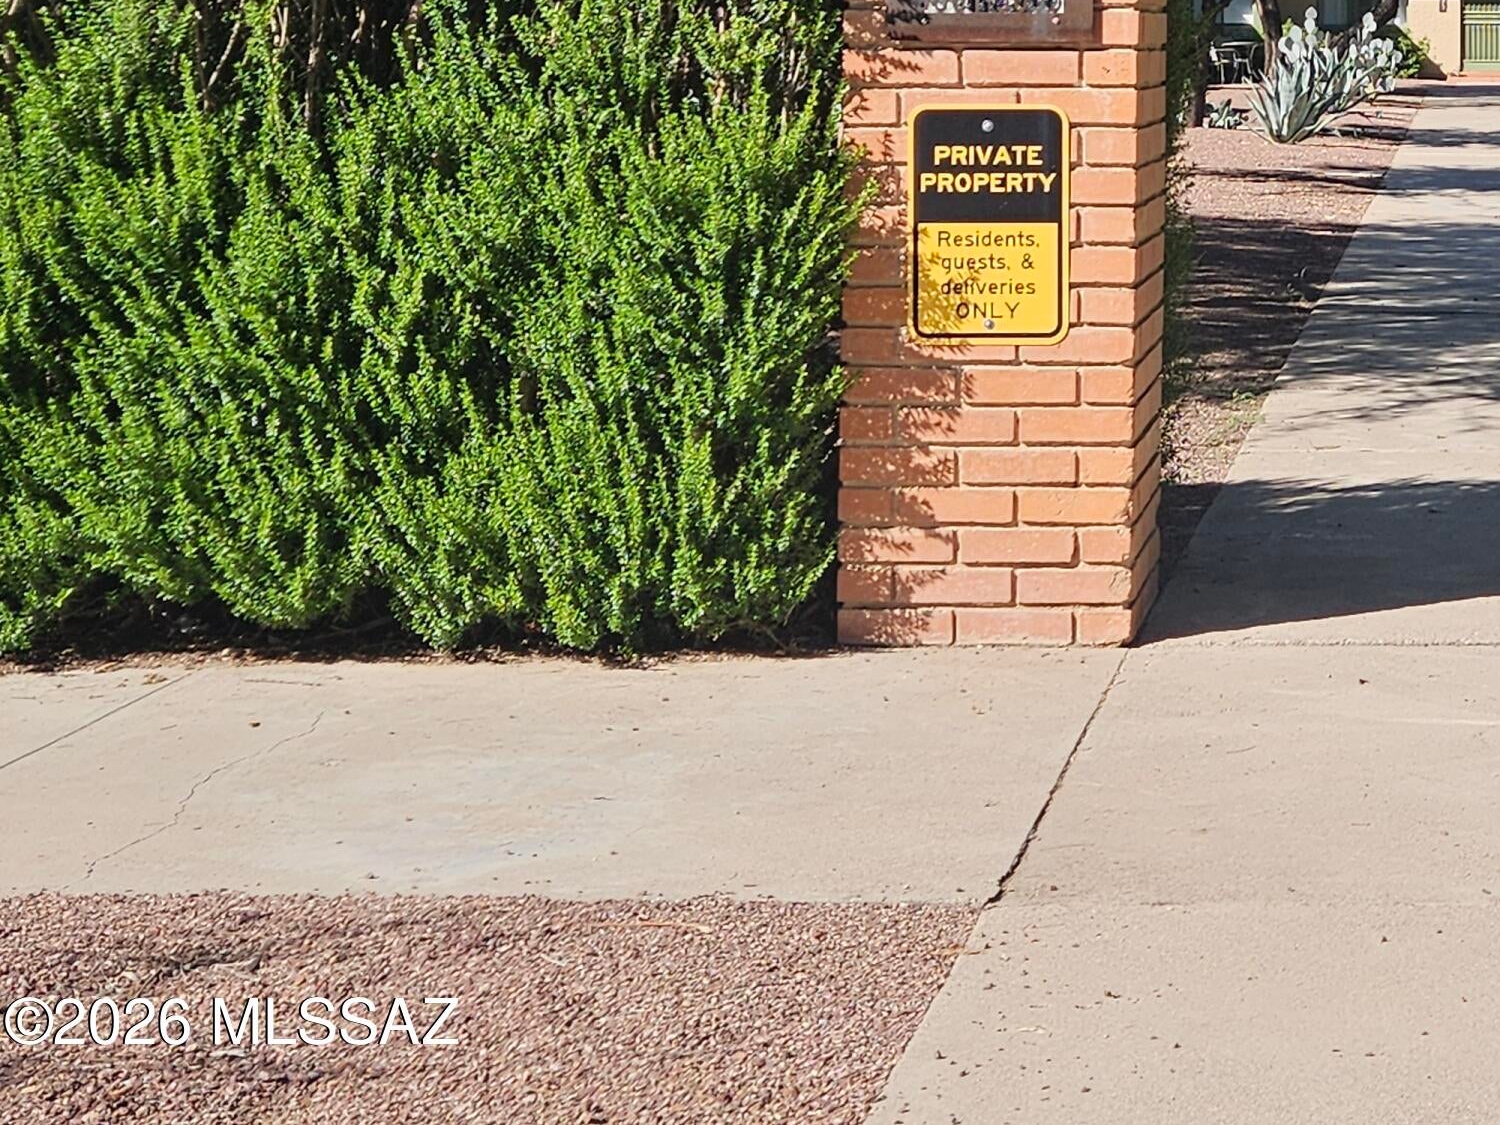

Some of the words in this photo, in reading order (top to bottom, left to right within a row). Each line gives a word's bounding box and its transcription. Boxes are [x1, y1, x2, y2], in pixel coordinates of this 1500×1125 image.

[934, 145, 1043, 166] PRIVATE
[920, 172, 1057, 193] PROPERTY
[1021, 253, 1035, 270] &
[940, 279, 1036, 295] deliveries
[956, 302, 1020, 319] ONLY
